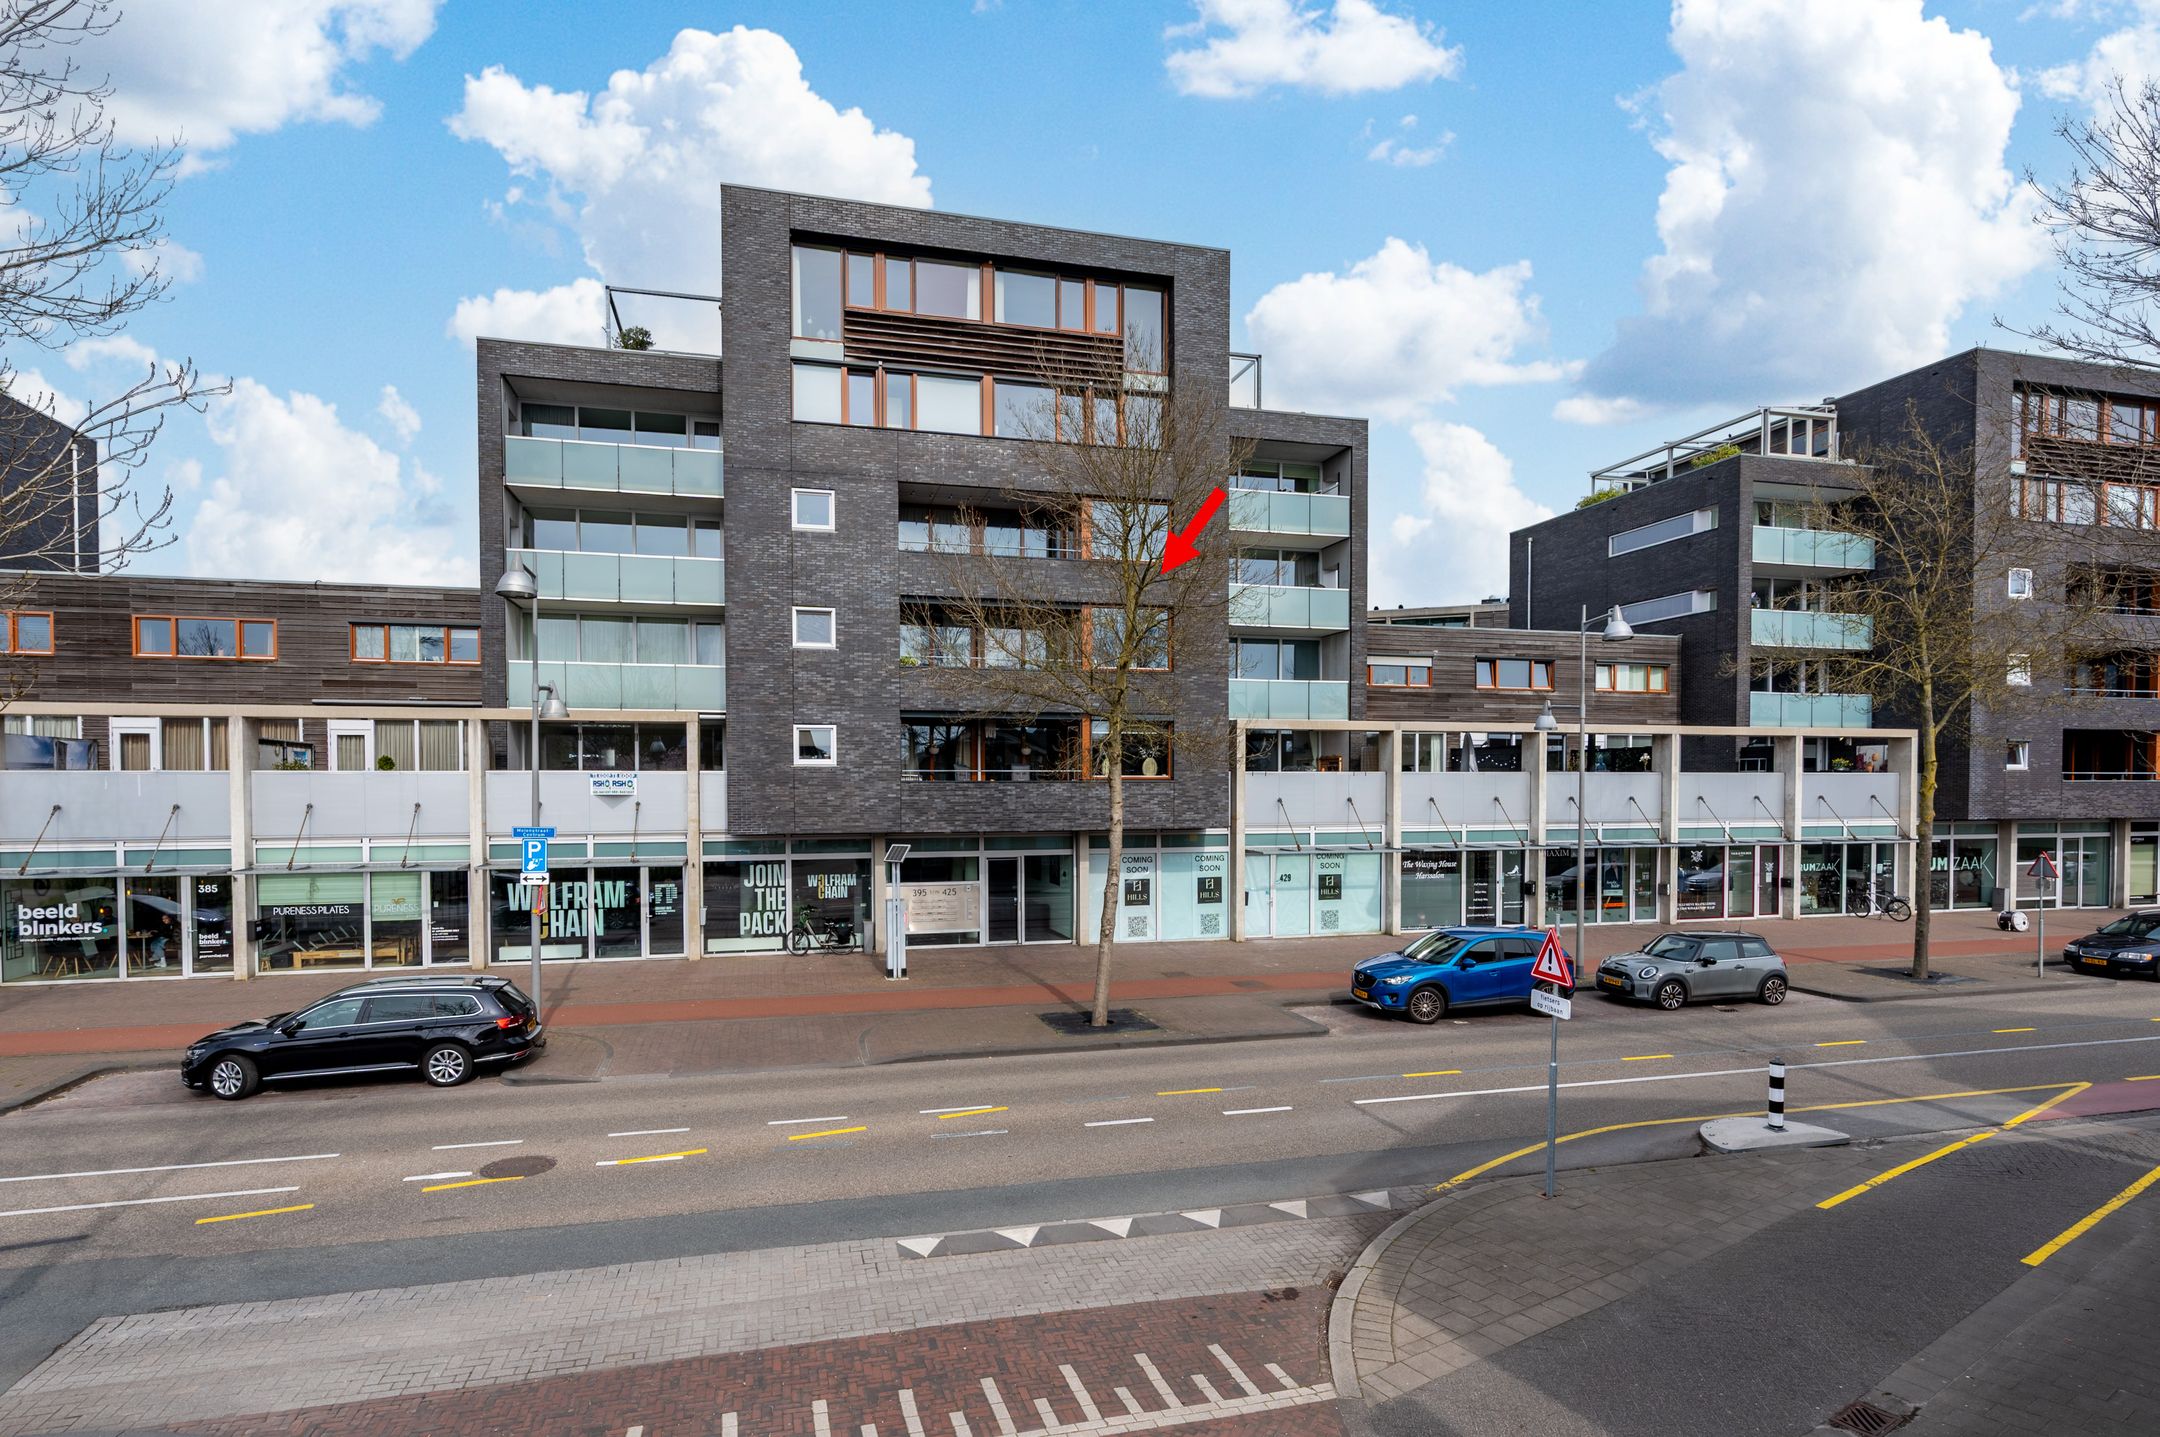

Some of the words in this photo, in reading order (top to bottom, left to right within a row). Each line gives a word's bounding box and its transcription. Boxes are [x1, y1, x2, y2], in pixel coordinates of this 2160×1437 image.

[528, 841, 541, 858] P
[1546, 849, 1570, 858] AXIM
[1121, 856, 1153, 864] COMING
[1402, 860, 1413, 868] The
[1415, 860, 1438, 870] Waxing
[1438, 860, 1457, 868] House
[1126, 866, 1149, 874] SOON
[1199, 864, 1221, 872] SOON
[1320, 862, 1340, 870] SOON
[743, 863, 785, 888] JOIN
[807, 873, 857, 887] WOLFRAM
[1279, 873, 1292, 882] 429
[198, 884, 218, 893] 385
[818, 885, 848, 900] CHAIN
[912, 888, 927, 897] 395
[942, 887, 957, 896] 425
[754, 887, 786, 911] THE
[1127, 893, 1148, 901] HILLS
[1199, 891, 1220, 899] HILLS
[18, 903, 77, 920] beeld
[273, 906, 317, 915] PURENESS
[317, 905, 350, 914] PILATES
[374, 904, 419, 913] PURENESS
[740, 911, 787, 935] PACK
[1540, 994, 1561, 1006] fietsers
[1544, 1005, 1564, 1016] rijbaan
